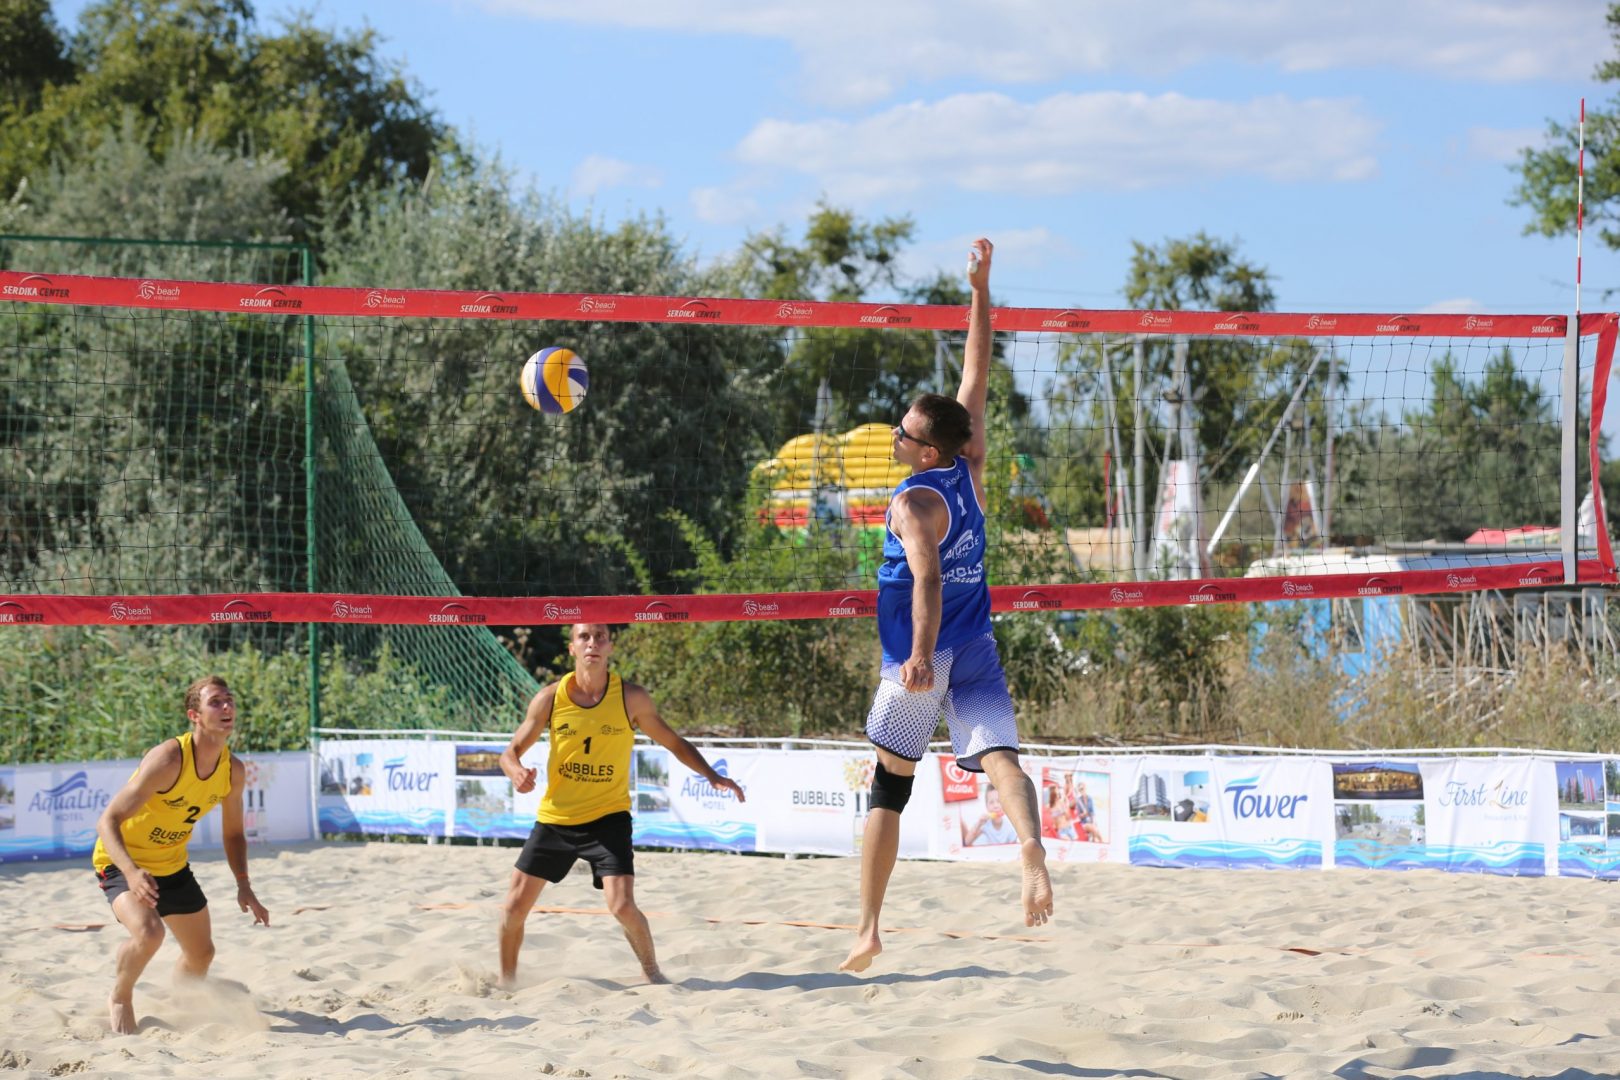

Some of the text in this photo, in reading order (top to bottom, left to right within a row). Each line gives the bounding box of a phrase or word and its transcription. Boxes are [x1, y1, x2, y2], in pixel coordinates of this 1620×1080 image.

[2, 286, 70, 298] SERDIKA CENTER
[157, 285, 180, 297] beach
[240, 298, 273, 308] SERDIKA
[382, 294, 406, 305] beach
[460, 304, 491, 313] SERDIKA
[594, 300, 616, 310] beach
[667, 309, 696, 318] SERDIKA
[793, 307, 813, 316] beach
[860, 315, 887, 323] SERDIKA
[957, 492, 967, 517] 1
[1295, 583, 1313, 592] beach
[1358, 587, 1382, 595] SERDIKA
[1124, 591, 1143, 600] beach
[1189, 594, 1214, 603] SERDIKA
[128, 605, 152, 615] beach
[350, 604, 372, 614] beach
[559, 605, 581, 615] beach
[759, 602, 779, 611] beach
[1013, 601, 1039, 609] SERDIKA
[211, 612, 244, 621] SERDIKA
[635, 612, 664, 621] SERDIKA
[829, 607, 856, 616] SERDIKA
[428, 614, 460, 623] SERDIKA
[582, 736, 592, 755] 1
[384, 763, 438, 792] Tower
[946, 784, 974, 794] ALGIDA
[792, 790, 846, 807] BUBBLES
[1439, 779, 1528, 810] First Line
[702, 801, 726, 810] HOTEL
[1223, 784, 1308, 820] Tower
[182, 805, 201, 825] 2
